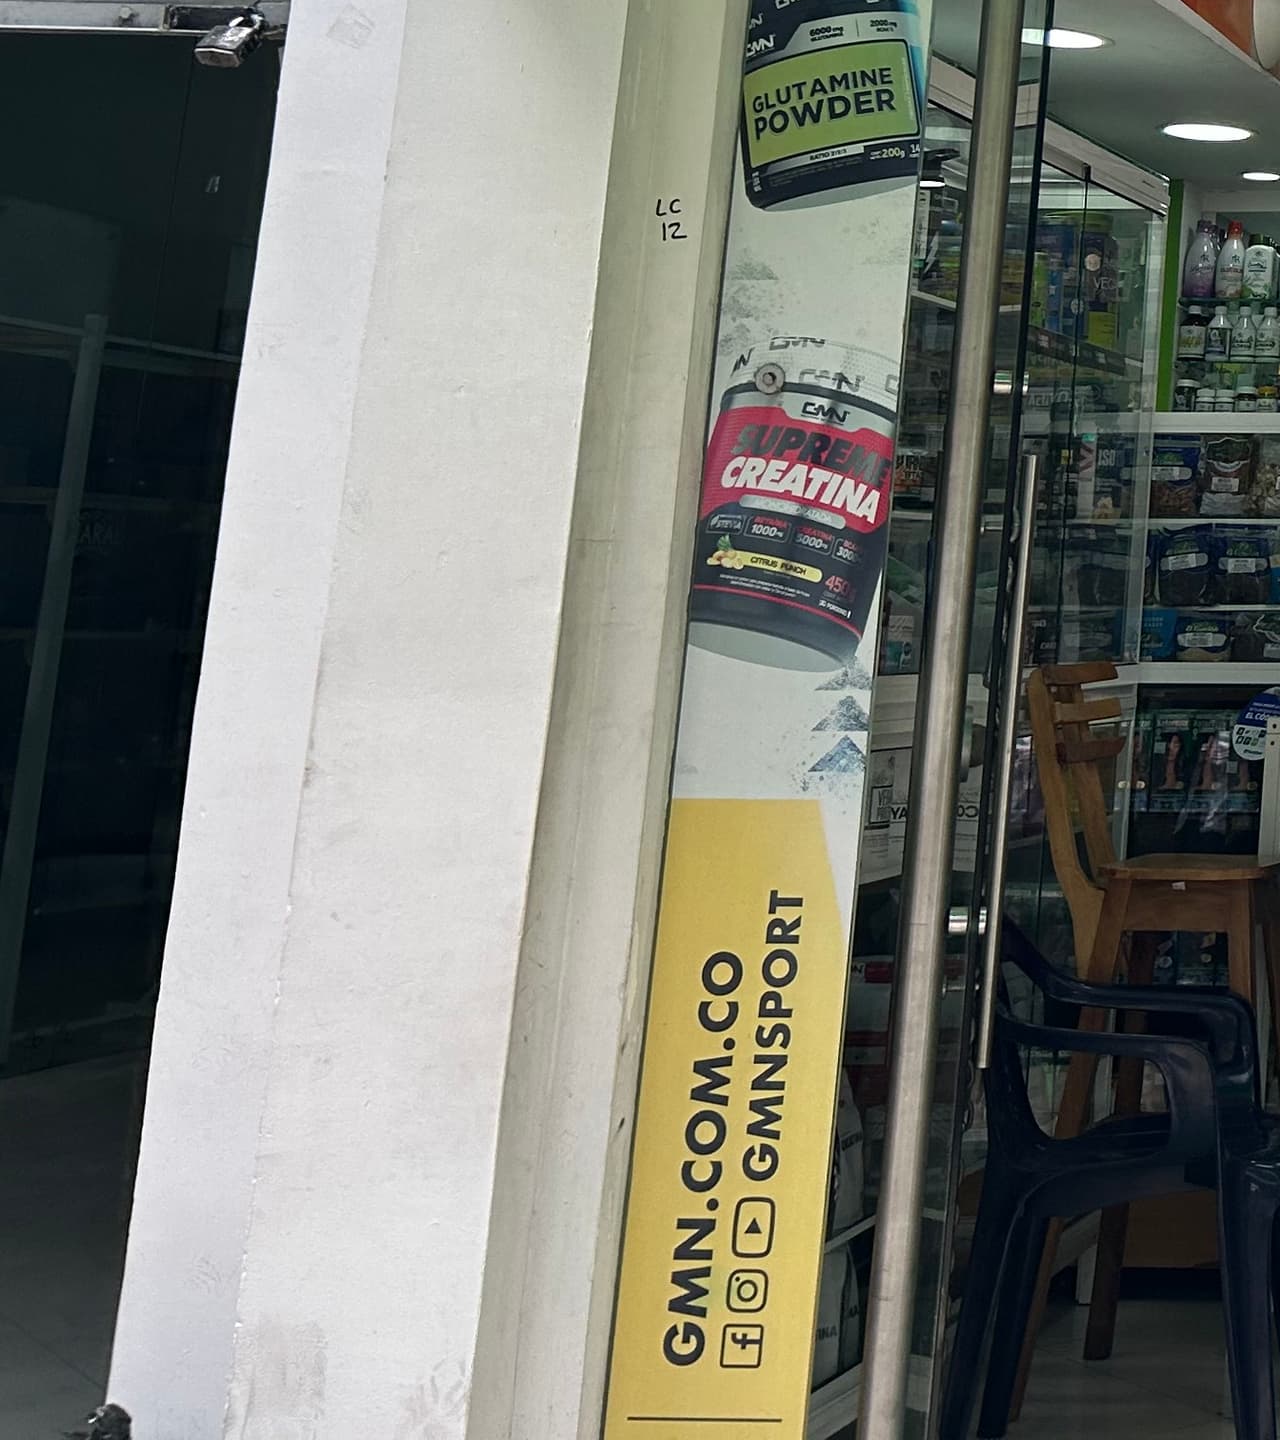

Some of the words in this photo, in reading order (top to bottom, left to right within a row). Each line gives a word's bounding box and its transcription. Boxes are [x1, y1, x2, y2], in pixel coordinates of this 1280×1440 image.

[752, 67, 894, 114] GLUTAMINE
[754, 88, 897, 141] POWDER
[655, 198, 682, 217] LC
[661, 222, 688, 242] 12
[729, 423, 892, 487] SUPREME
[720, 455, 882, 524] CREATINA
[750, 556, 778, 569] CITRUS
[741, 888, 805, 1183] GMNSPORT
[662, 950, 744, 1367] GMN.COM.CO
